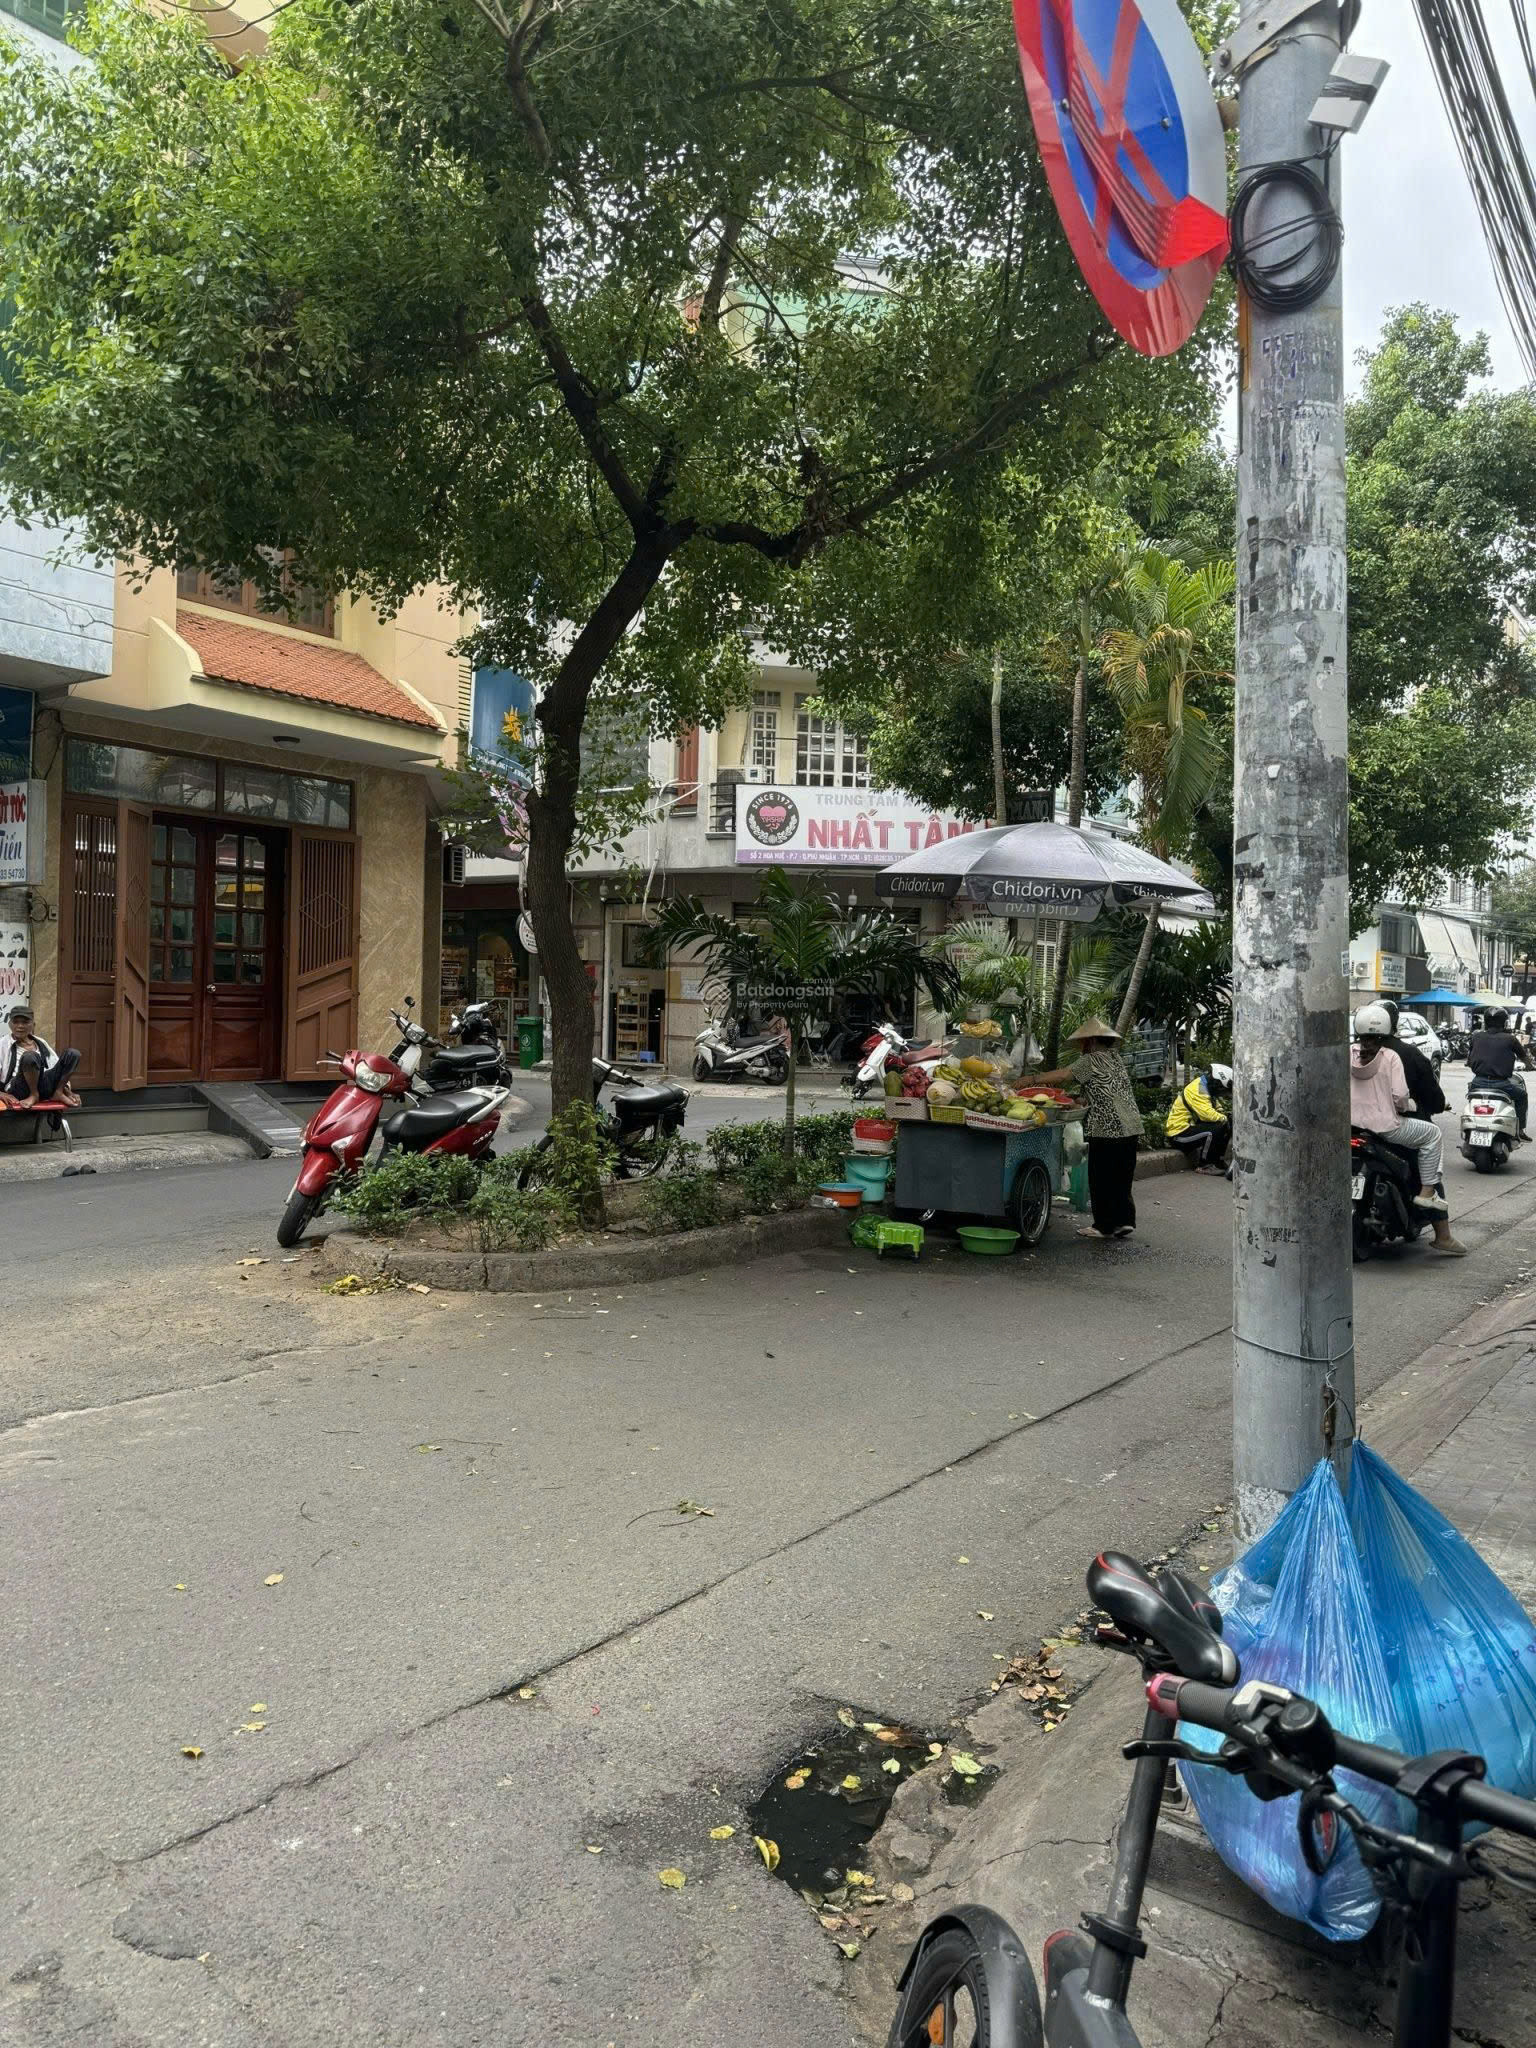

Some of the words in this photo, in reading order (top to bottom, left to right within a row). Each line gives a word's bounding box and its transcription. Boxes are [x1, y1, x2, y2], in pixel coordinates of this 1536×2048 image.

[752, 793, 774, 809] SINCE
[816, 793, 862, 806] TRUNG
[807, 809, 895, 849] NHẤT
[891, 877, 945, 893] Chidori.vn
[992, 880, 1082, 900] Chidori.vn
